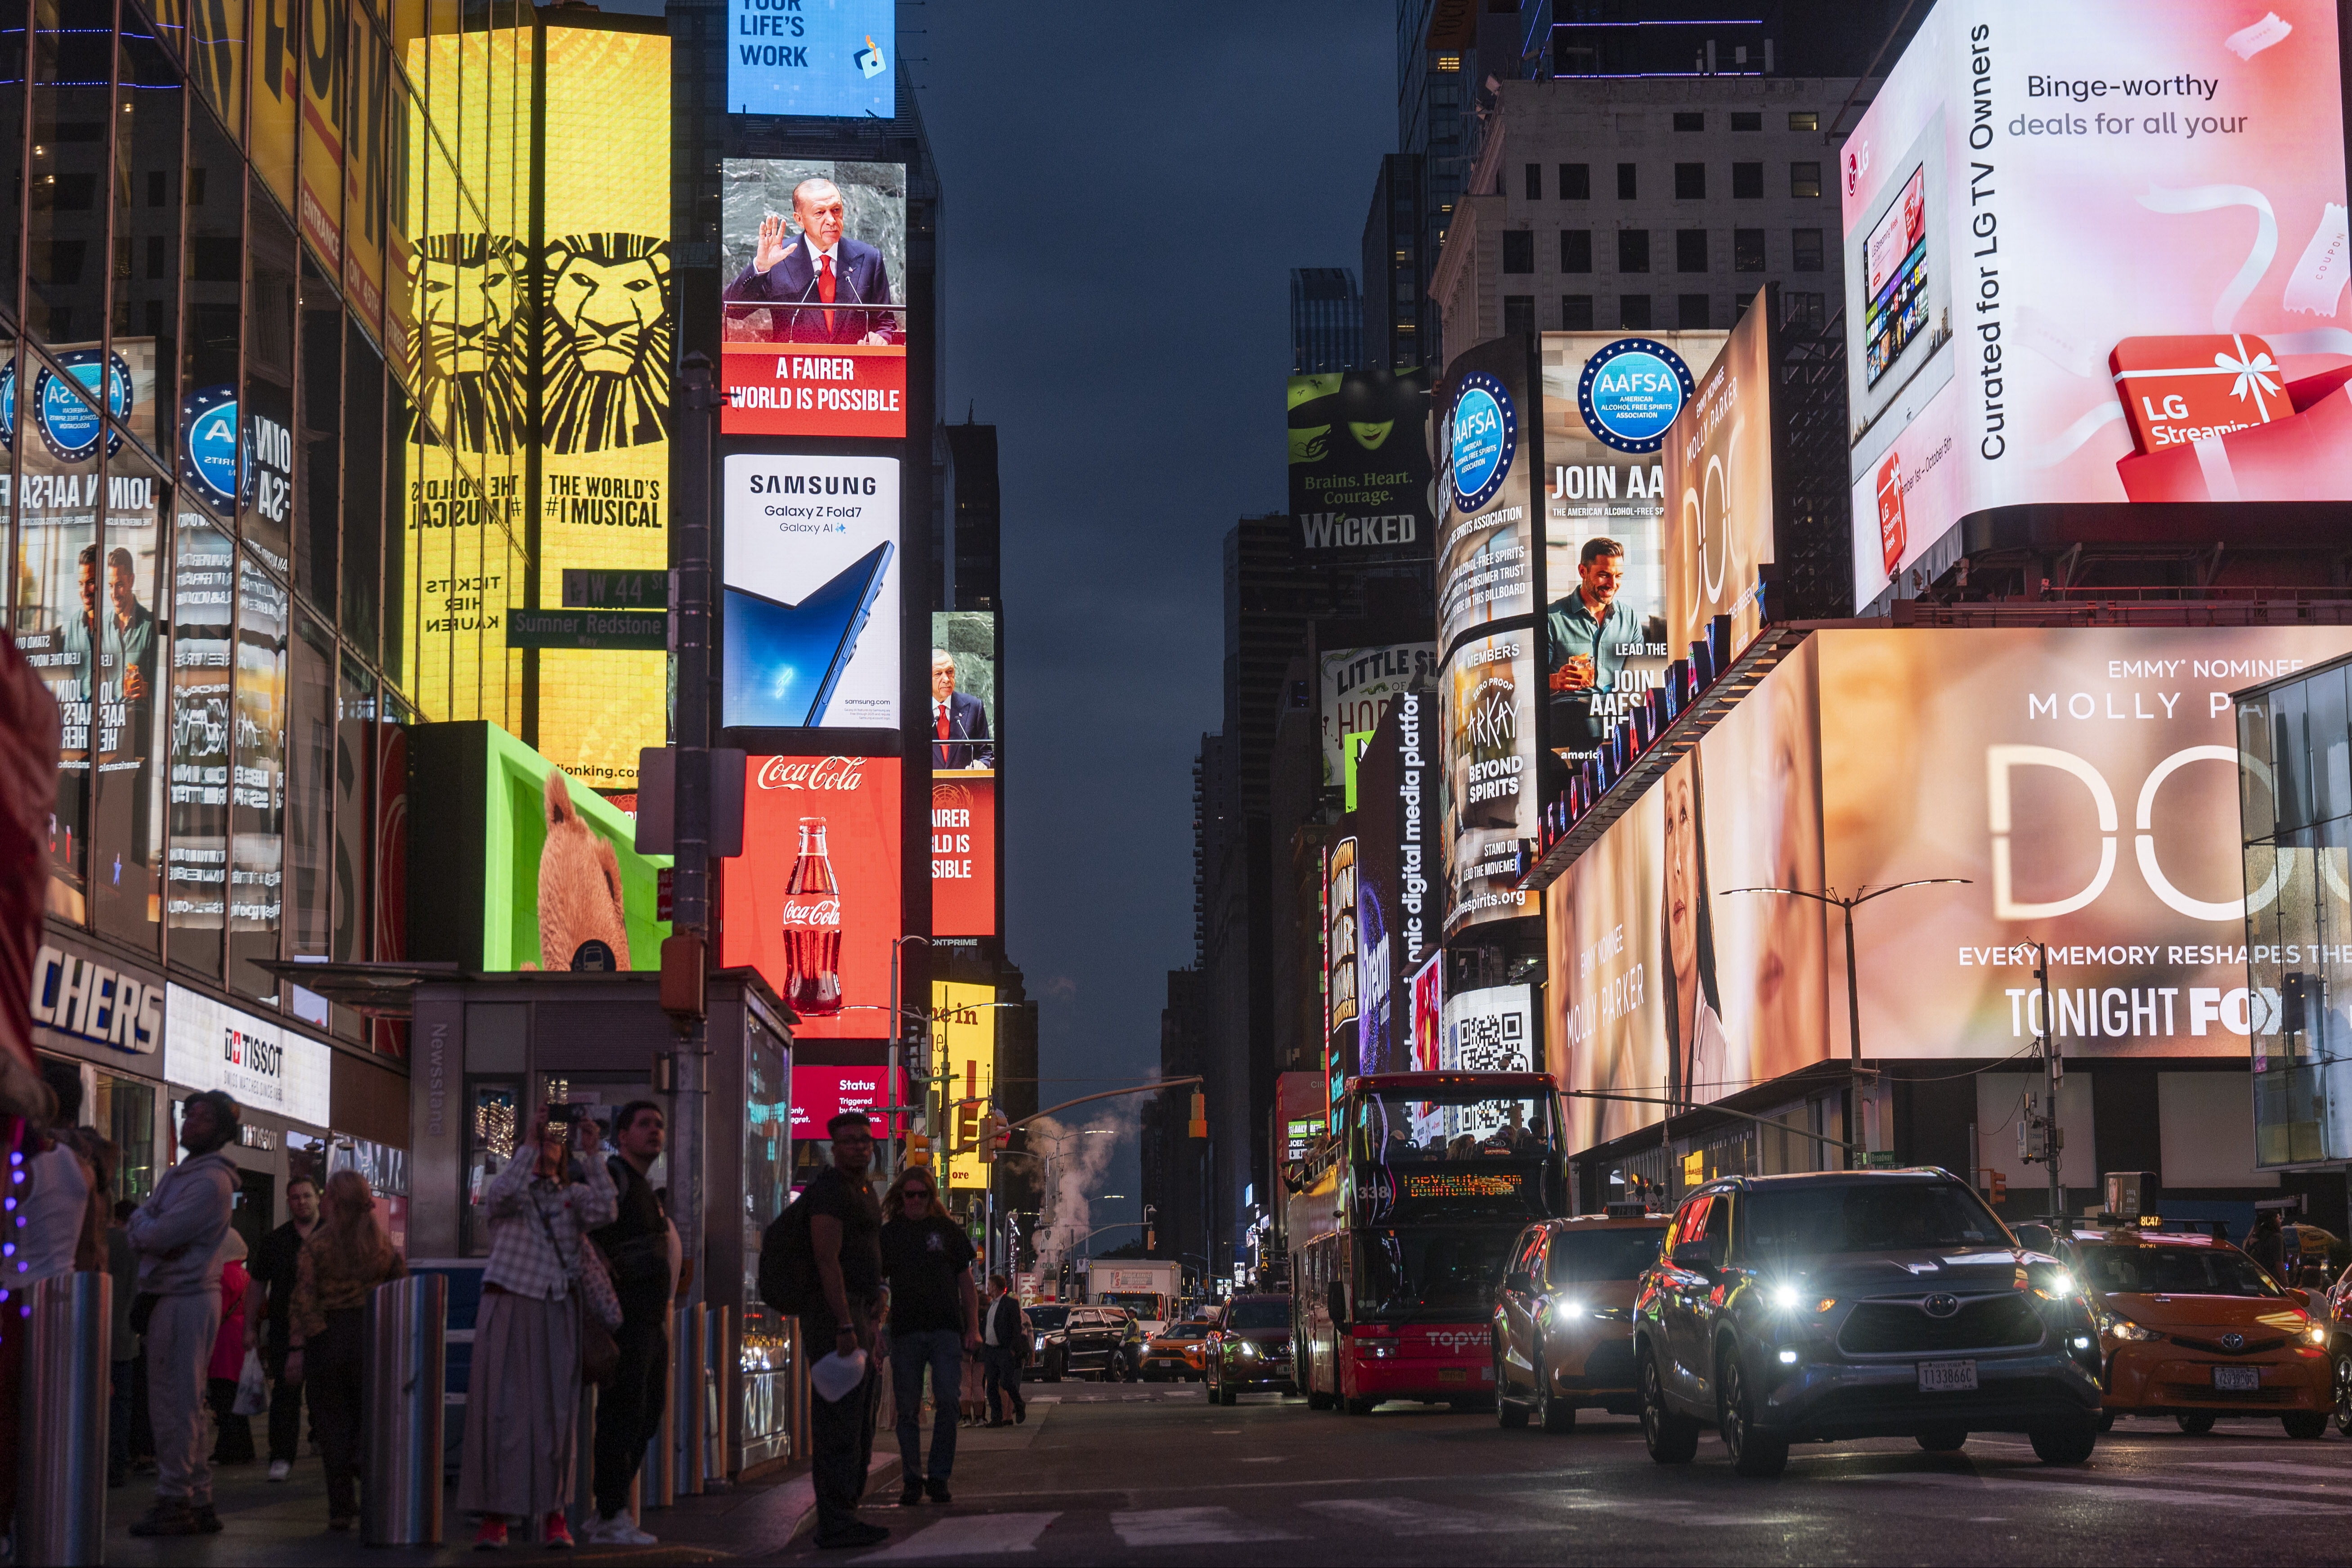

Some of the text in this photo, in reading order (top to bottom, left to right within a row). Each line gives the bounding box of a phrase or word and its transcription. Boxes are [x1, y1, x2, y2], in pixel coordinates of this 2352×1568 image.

[741, 15, 804, 37] LIFE'S
[740, 45, 808, 67] WORK
[2028, 74, 2218, 103] Binge-worthy
[2008, 112, 2248, 139] deals for all your
[1857, 140, 1869, 180] LG
[304, 190, 381, 317] ENTRANCE ON 45TH
[1970, 23, 2005, 460] Curated for LG TV Owners
[2315, 232, 2346, 280] COUPON
[776, 357, 854, 381] A FAIRER
[1600, 373, 1673, 392] AAFSA
[1708, 365, 1725, 400] NOMINEE
[730, 386, 899, 412] WORLD IS POSSIBLE
[2142, 395, 2189, 421] LG
[1455, 409, 1497, 446] AAFSA
[1687, 376, 1738, 467] MOLLY PARKER
[1456, 445, 1497, 468] ALCOHOL FREE SPIRITS
[1463, 440, 1482, 453] AMERICAN
[1926, 446, 1944, 473] October
[1944, 435, 1952, 455] 5th
[1461, 458, 1486, 474] ASSOCIATION
[549, 475, 660, 500] THE WORLD'S
[750, 474, 876, 495] SAMSUNG
[1305, 471, 1413, 490] Brains. Heart.
[1552, 465, 1616, 499] JOIN
[1324, 489, 1393, 506] Courage.
[545, 496, 662, 528] #1 MUSICAL
[764, 505, 862, 520] Galaxy Z Fold7
[1473, 506, 1522, 532] ASSOCIATION
[1553, 508, 1566, 516] THE
[1567, 508, 1602, 516] AMERICAN
[1604, 507, 1653, 516] ALCOHOL-FREE
[1882, 502, 1889, 523] LG
[780, 523, 833, 535] Galaxy AI
[1883, 511, 1900, 538] Streaming
[1885, 534, 1895, 553] Week
[1459, 545, 1525, 577] ALCOHOL-FREE SPIRITS
[591, 574, 606, 602] W
[615, 575, 642, 603] 44
[1464, 581, 1468, 592] &
[1468, 570, 1499, 590] CONSUMER
[1500, 564, 1525, 580] TRUST
[1465, 596, 1471, 609] ON
[1472, 590, 1484, 606] THIS
[1485, 582, 1525, 602] BILLBOARD
[1737, 582, 1755, 614] PRESENT
[515, 613, 661, 635] Sumner Redstone
[578, 635, 598, 647] Way
[1616, 643, 1667, 656] LEAD THE
[1467, 643, 1520, 669] MEMBERS
[1337, 649, 1409, 696] LITTLE
[1611, 670, 1659, 692] JOIN
[1473, 677, 1514, 701] ZERO PROOF
[2029, 692, 2181, 719] MOLLY
[1468, 692, 1521, 750] ARKAY
[757, 755, 867, 791] Coca-Cola
[1469, 755, 1524, 783] BEYOND
[1399, 692, 1427, 914] digital media platfor
[956, 835, 970, 853] IS
[1485, 841, 1505, 855] STAND
[1463, 866, 1484, 881] LEAD THE
[783, 899, 840, 925] Coca-Cola
[1598, 923, 1623, 965] NOMINEE
[1959, 944, 2352, 966] EVERY MEMORY RESHAPES THE
[955, 1002, 978, 1025] in
[1567, 963, 1644, 1048] MOLLY PARKER
[2005, 987, 2178, 1037] TONIGHT
[242, 1034, 283, 1078] TISSOT
[428, 1024, 448, 1137] Newsstand
[839, 1079, 875, 1091] Status
[839, 1097, 872, 1106] Triggered
[839, 1106, 848, 1115] by
[252, 1126, 278, 1150] TISSOT
[1872, 1153, 1892, 1163] Broadway
[1358, 1186, 1388, 1199] 338
[2141, 1216, 2159, 1227] 8C47
[1923, 1367, 1972, 1384] T133866C
